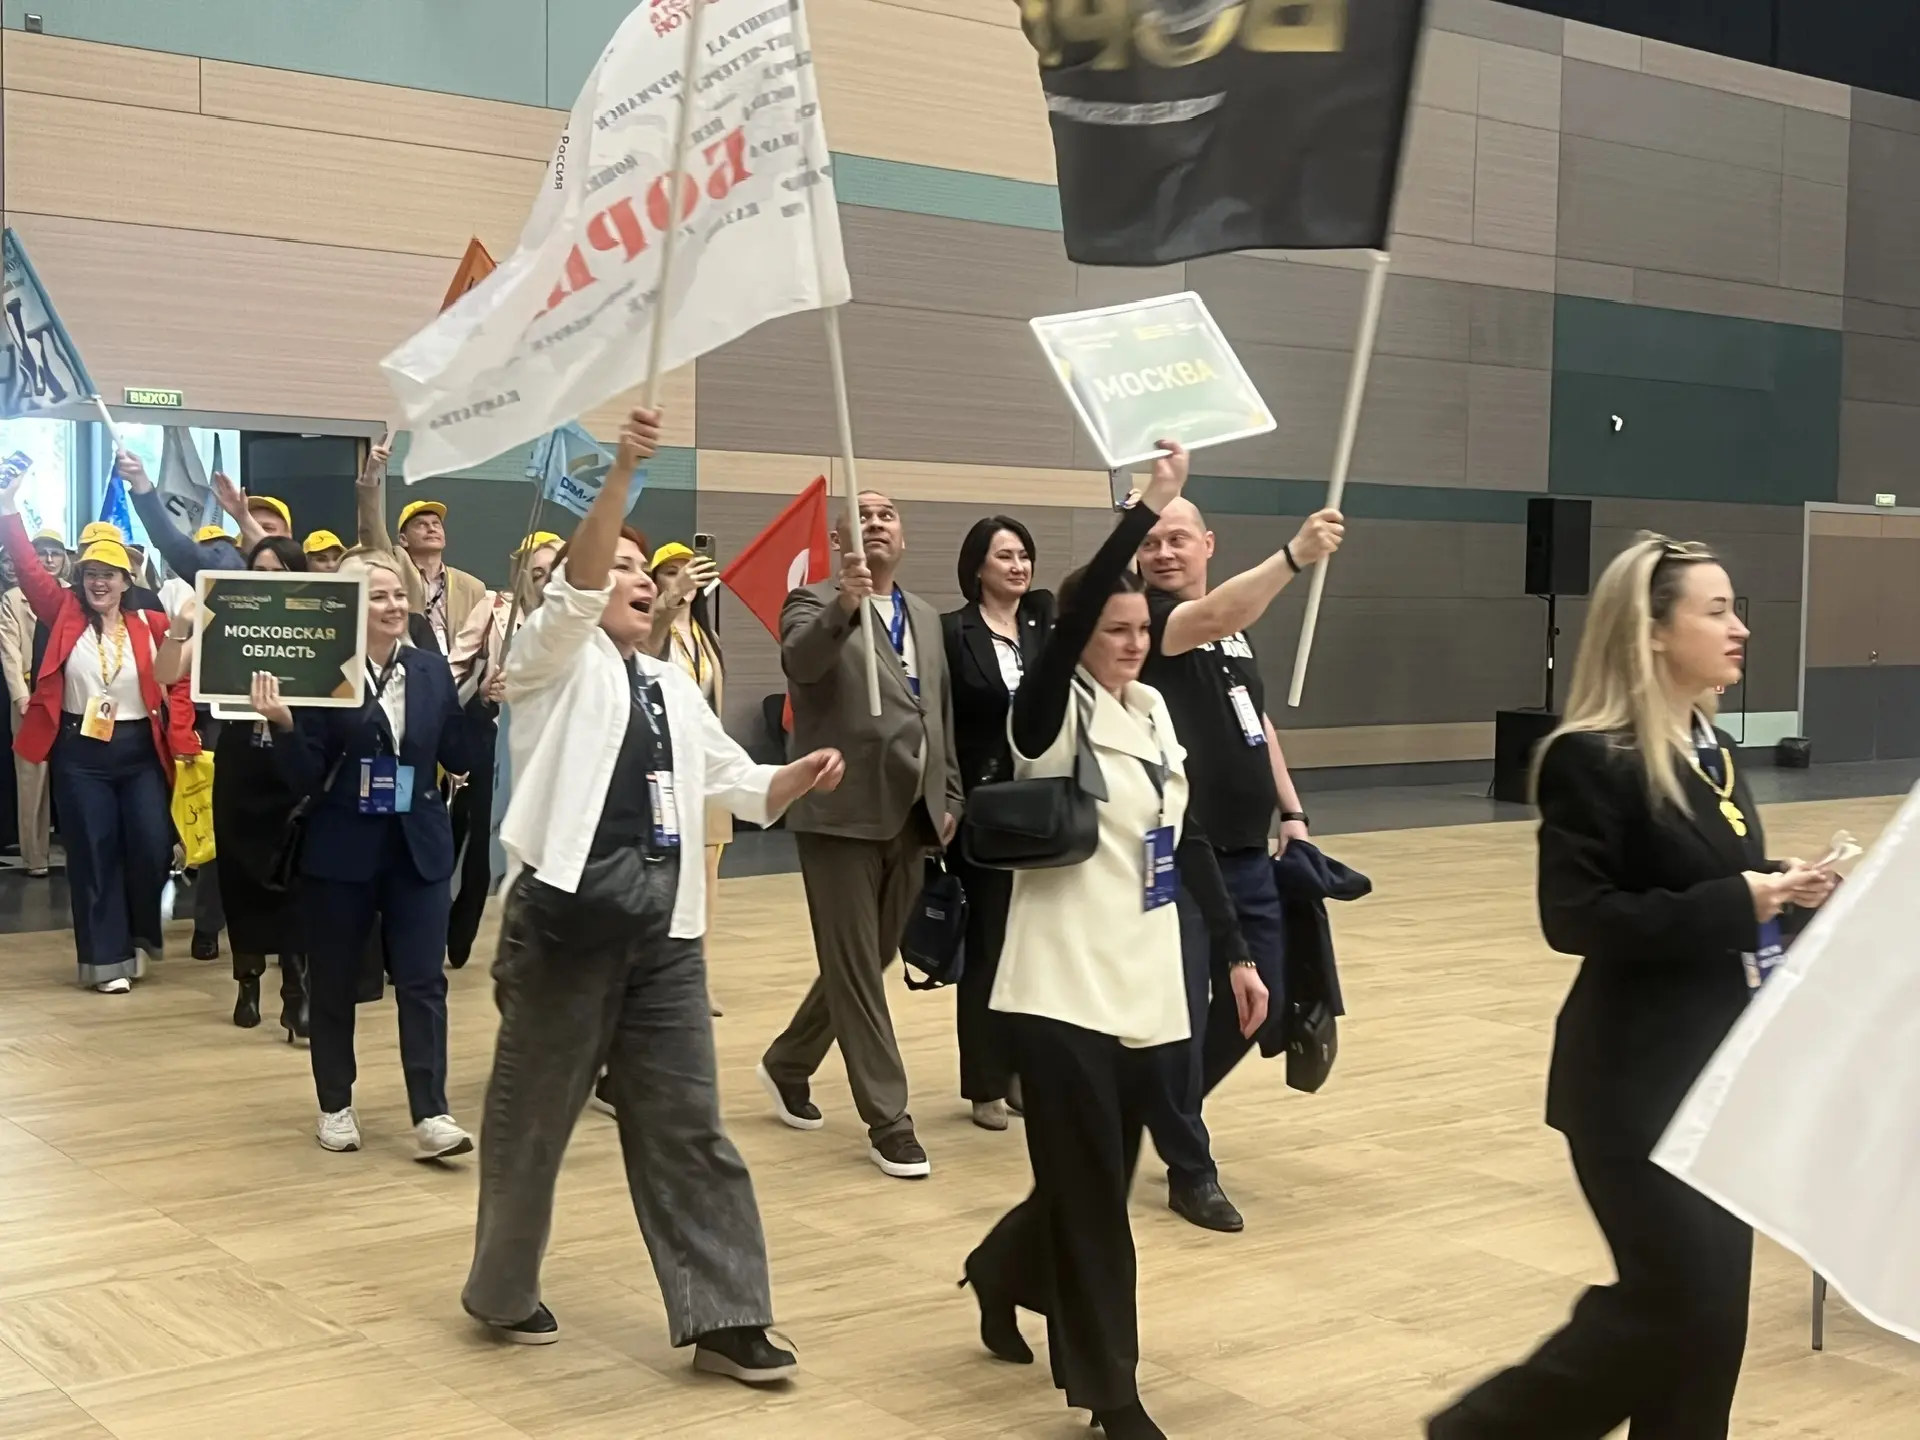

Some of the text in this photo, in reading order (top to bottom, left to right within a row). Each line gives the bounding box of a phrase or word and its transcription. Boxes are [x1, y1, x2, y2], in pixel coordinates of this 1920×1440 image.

[553, 135, 570, 190] РОССИЯ
[1093, 357, 1218, 403] МОСКВА
[129, 391, 179, 406] ВЫХОД
[224, 624, 337, 640] МОСКОВСКАЯ
[242, 644, 316, 659] ОБЛАСТЬ
